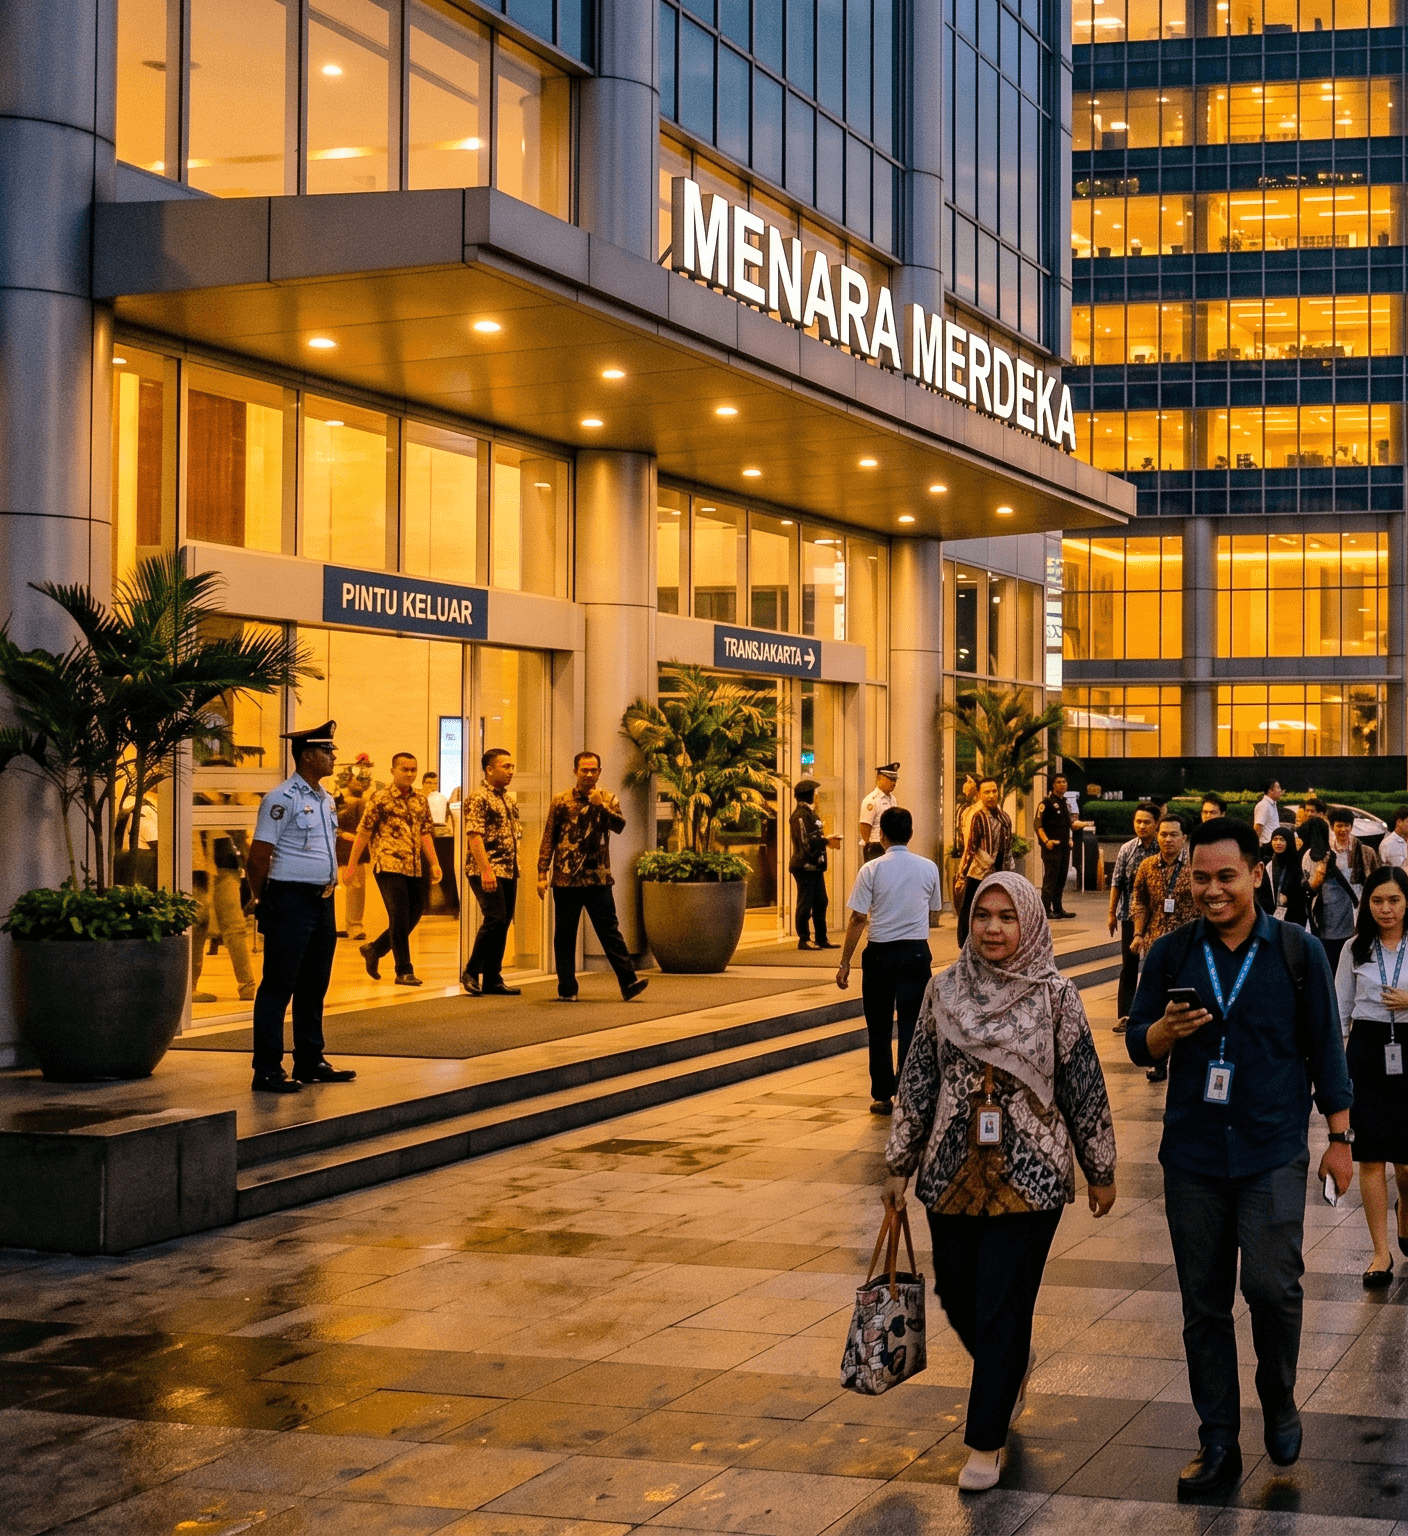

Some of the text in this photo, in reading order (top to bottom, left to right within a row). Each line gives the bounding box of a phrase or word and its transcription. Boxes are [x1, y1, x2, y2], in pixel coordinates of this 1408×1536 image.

[683, 176, 1077, 451] MENARA MERDEKA
[342, 582, 473, 625] PINTU KELUAR
[723, 636, 802, 666] TRANSJAKARTA
